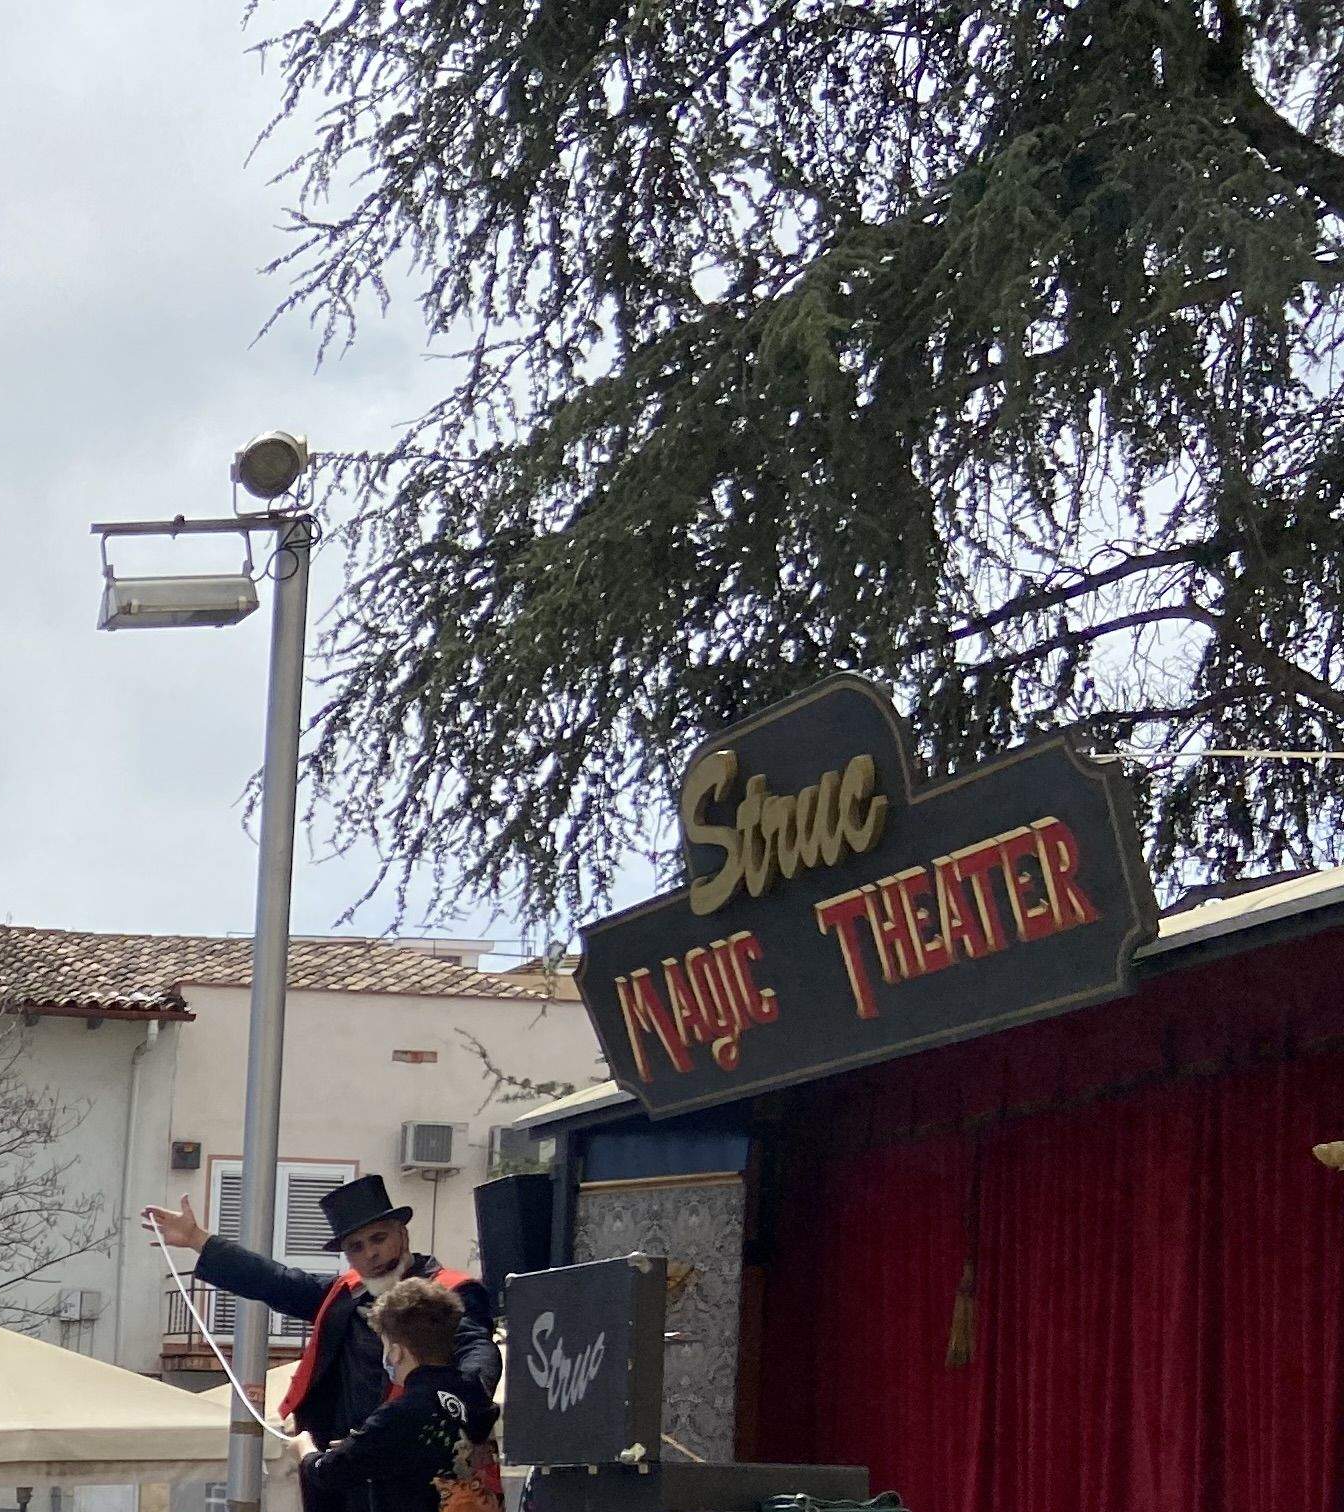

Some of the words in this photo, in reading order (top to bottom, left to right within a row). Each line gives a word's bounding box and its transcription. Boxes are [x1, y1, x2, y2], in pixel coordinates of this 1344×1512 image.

[681, 750, 888, 916] Struc
[614, 930, 780, 1084] MAGIC
[813, 815, 1101, 1020] THEATER
